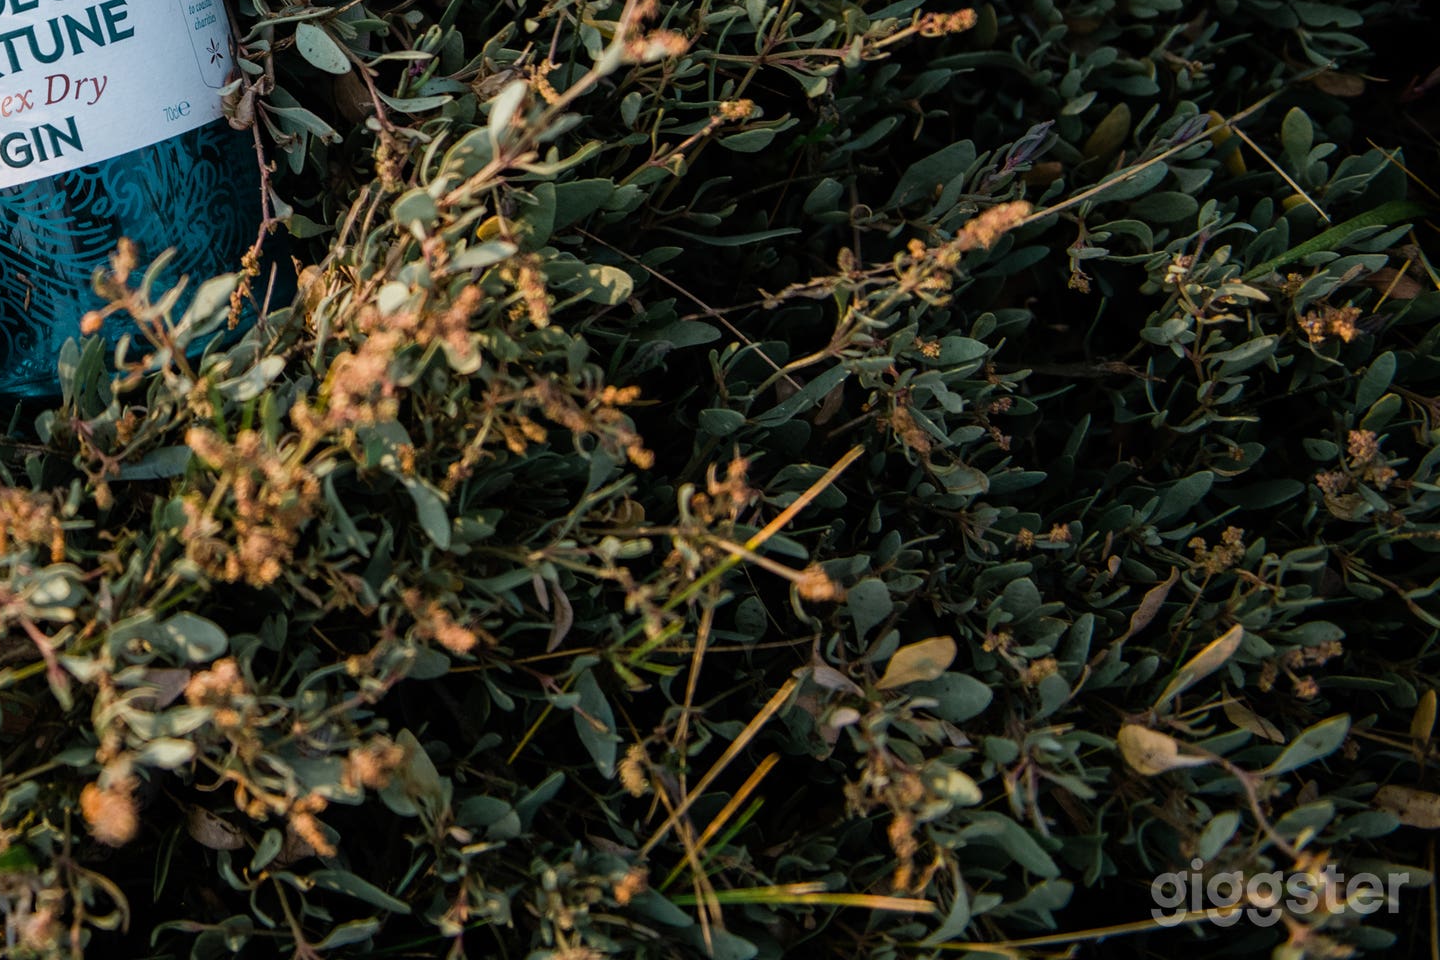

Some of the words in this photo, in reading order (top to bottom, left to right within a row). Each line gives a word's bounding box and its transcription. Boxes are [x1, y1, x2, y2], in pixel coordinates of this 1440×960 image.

[188, 4, 196, 15] to
[194, 13, 217, 30] charities
[44, 73, 108, 106] Dry
[0, 116, 84, 169] GIN
